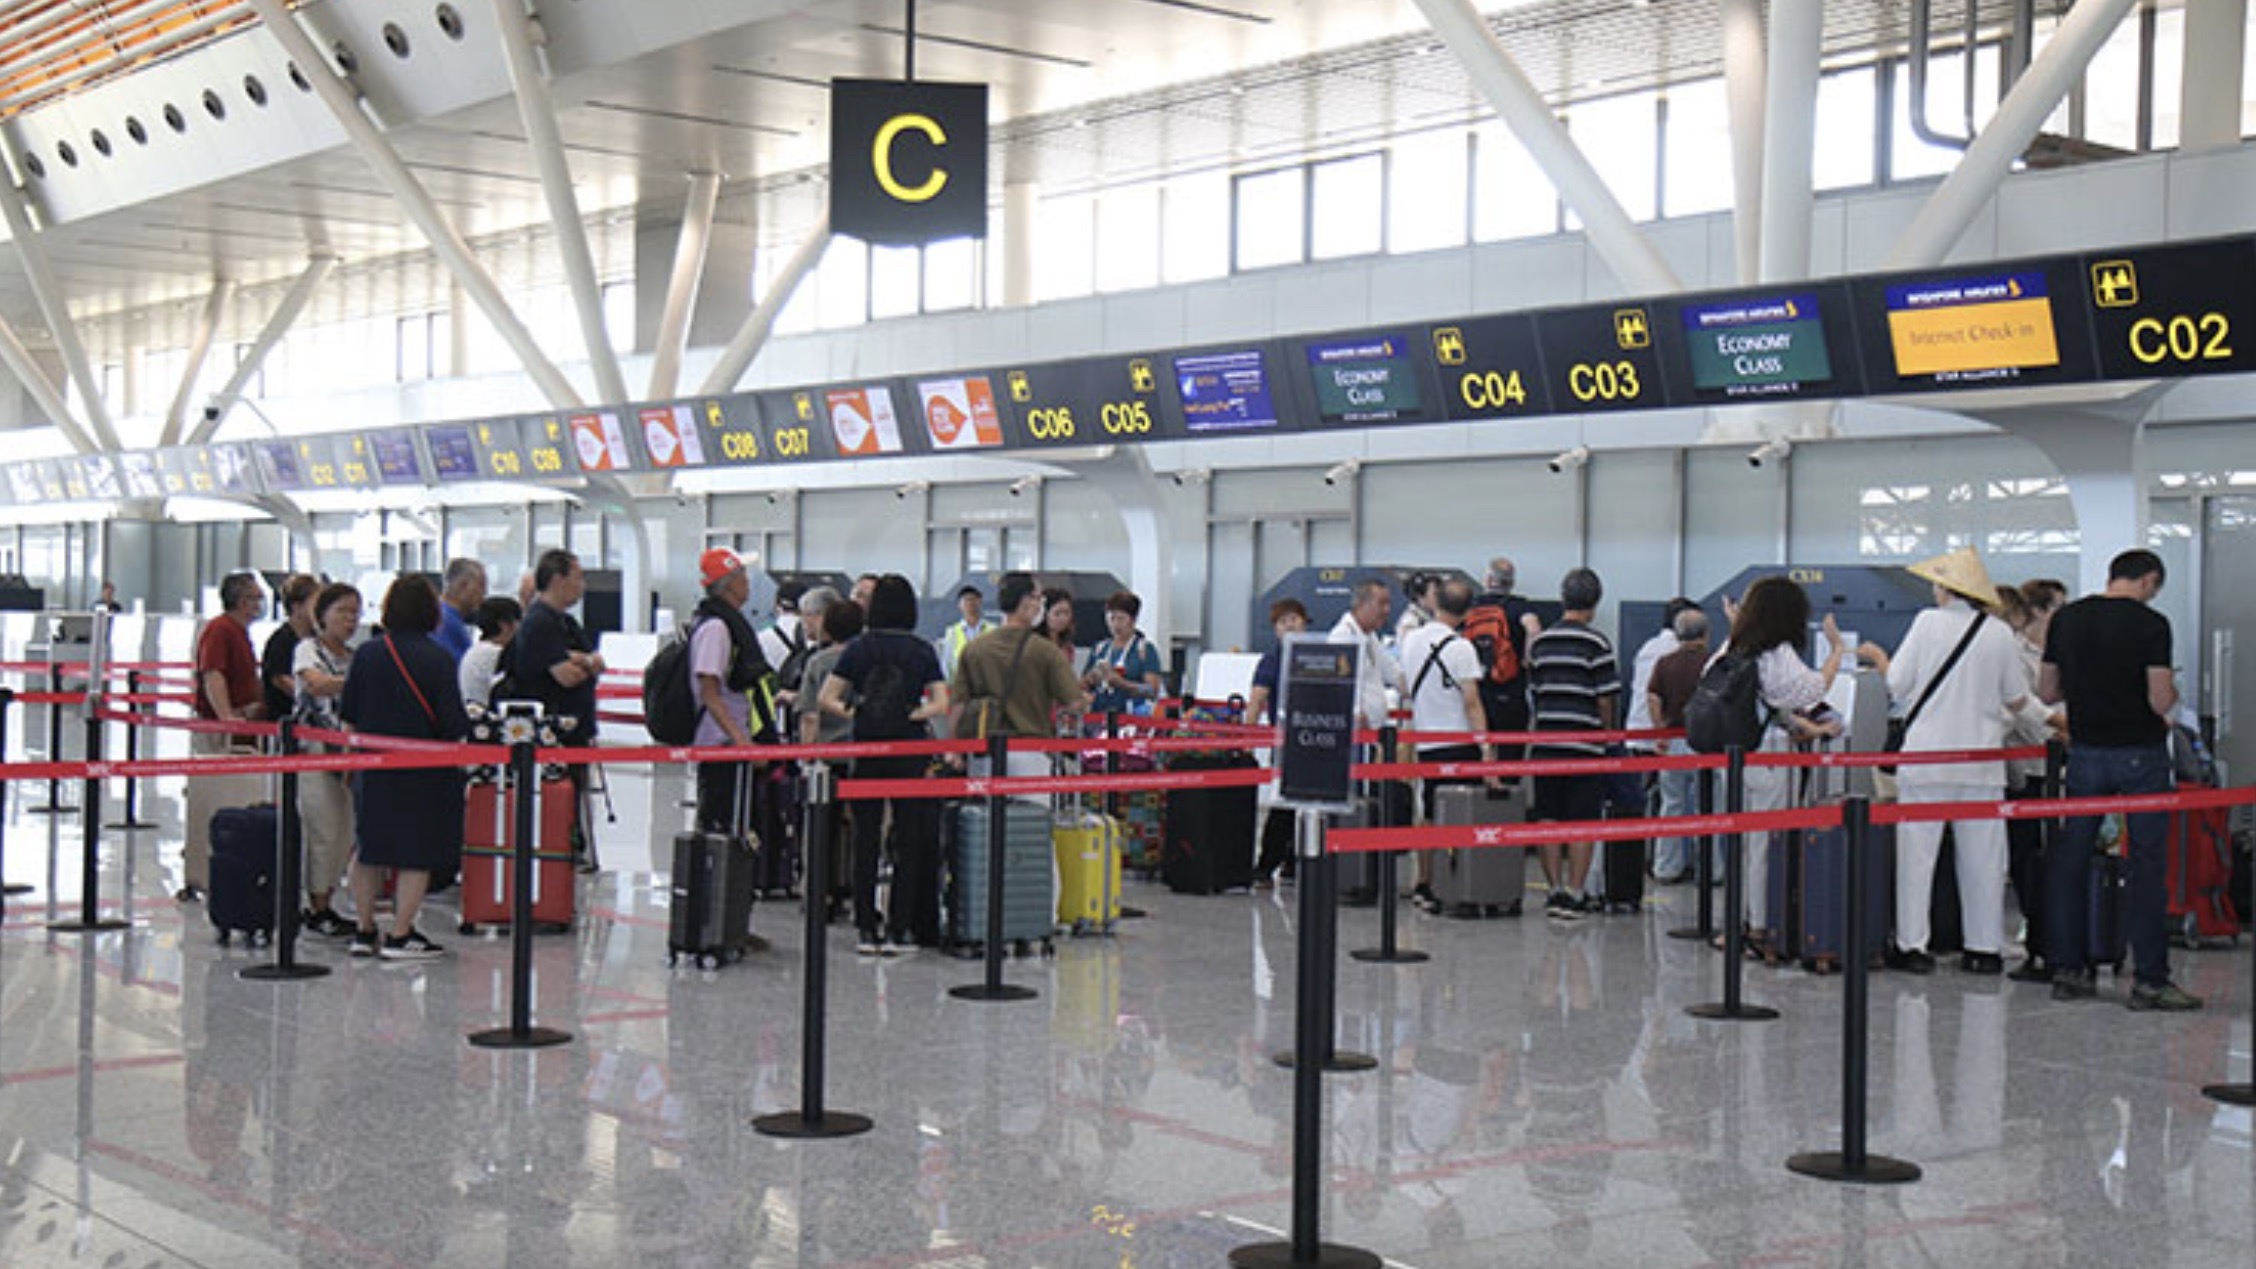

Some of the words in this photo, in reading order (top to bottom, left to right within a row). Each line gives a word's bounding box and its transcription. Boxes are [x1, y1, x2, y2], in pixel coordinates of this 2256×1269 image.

[872, 113, 948, 202] C
[2129, 312, 2232, 363] C02
[1569, 360, 1640, 401] C03
[1734, 354, 1783, 375] CLASS
[1461, 371, 1526, 408] C04
[1027, 407, 1075, 439] C06
[1101, 401, 1151, 434] C05
[775, 428, 809, 456] C07
